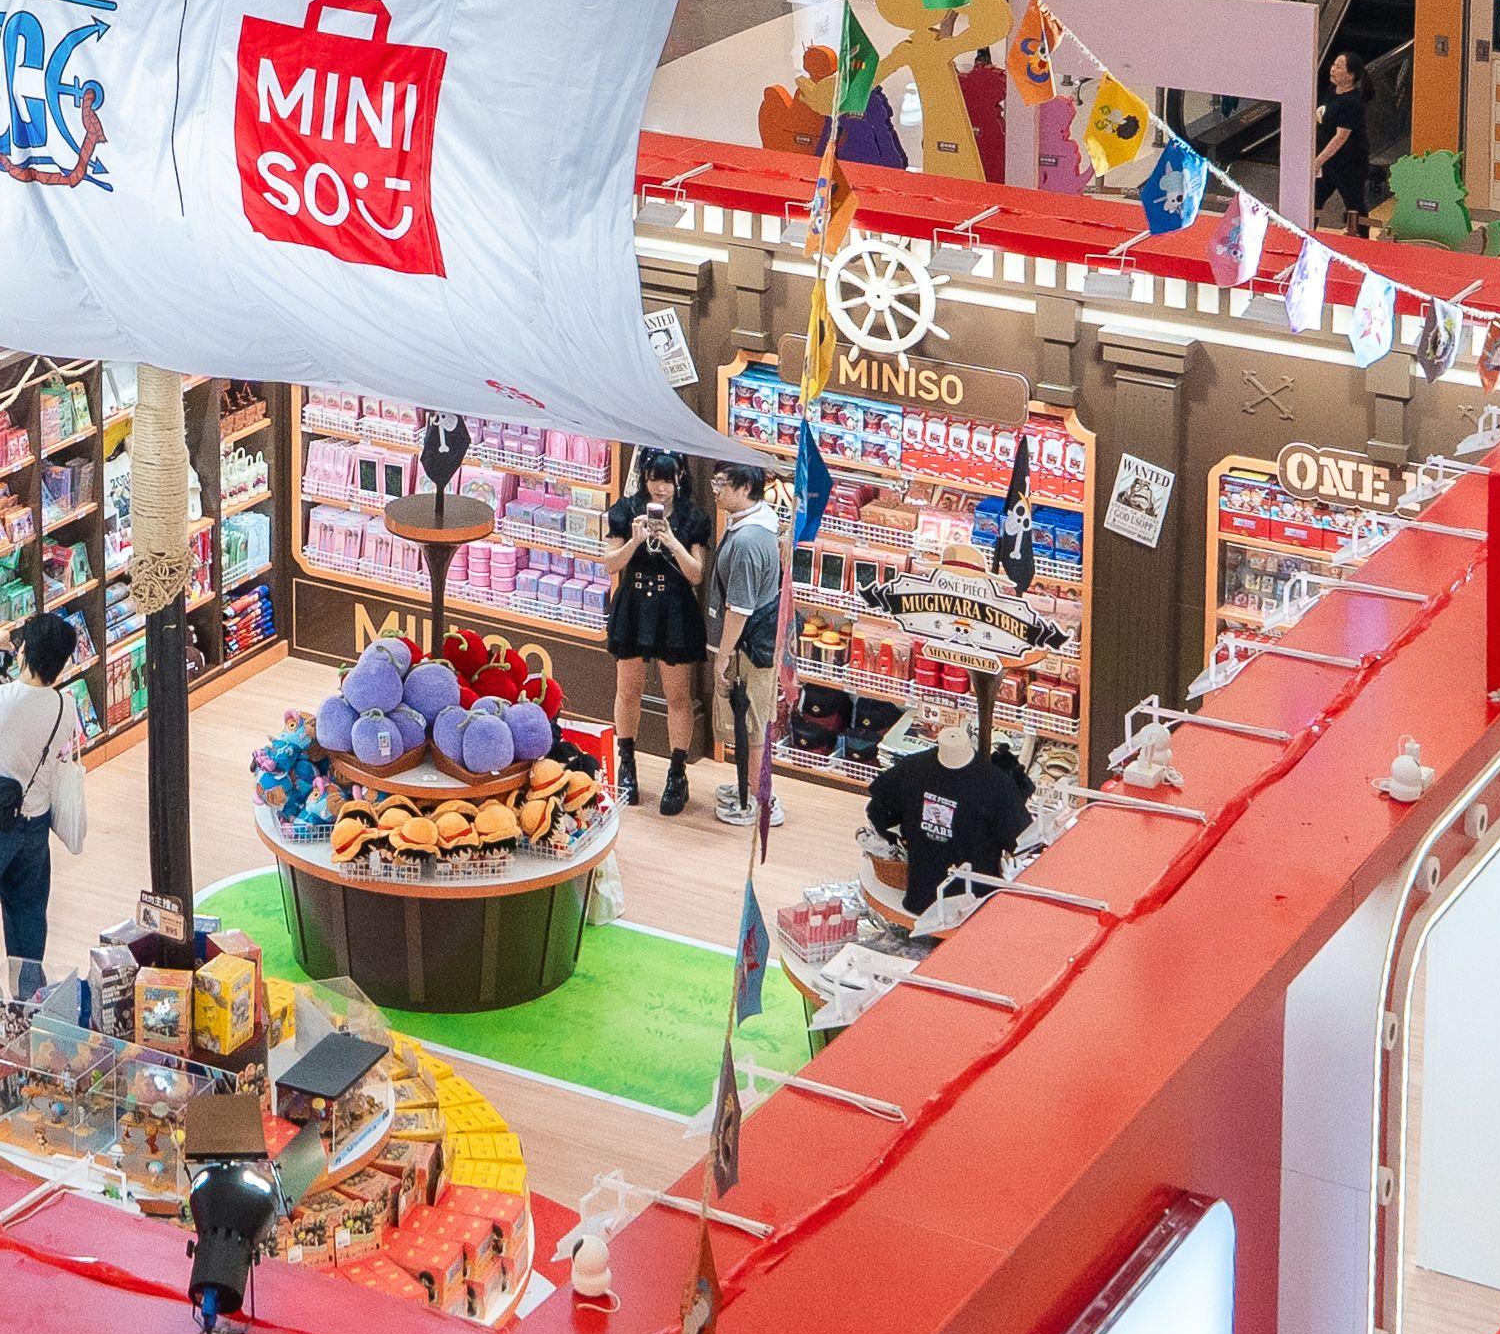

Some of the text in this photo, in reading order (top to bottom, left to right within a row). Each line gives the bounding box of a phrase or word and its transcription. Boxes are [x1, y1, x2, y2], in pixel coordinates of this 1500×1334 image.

[256, 58, 416, 152] MINI
[838, 354, 965, 407] MINISO
[1122, 457, 1170, 488] WANTED
[1285, 452, 1391, 507] ONE
[938, 578, 989, 599] ONE PIECE
[902, 595, 981, 619] MUGIWARA
[929, 647, 952, 659] MINI
